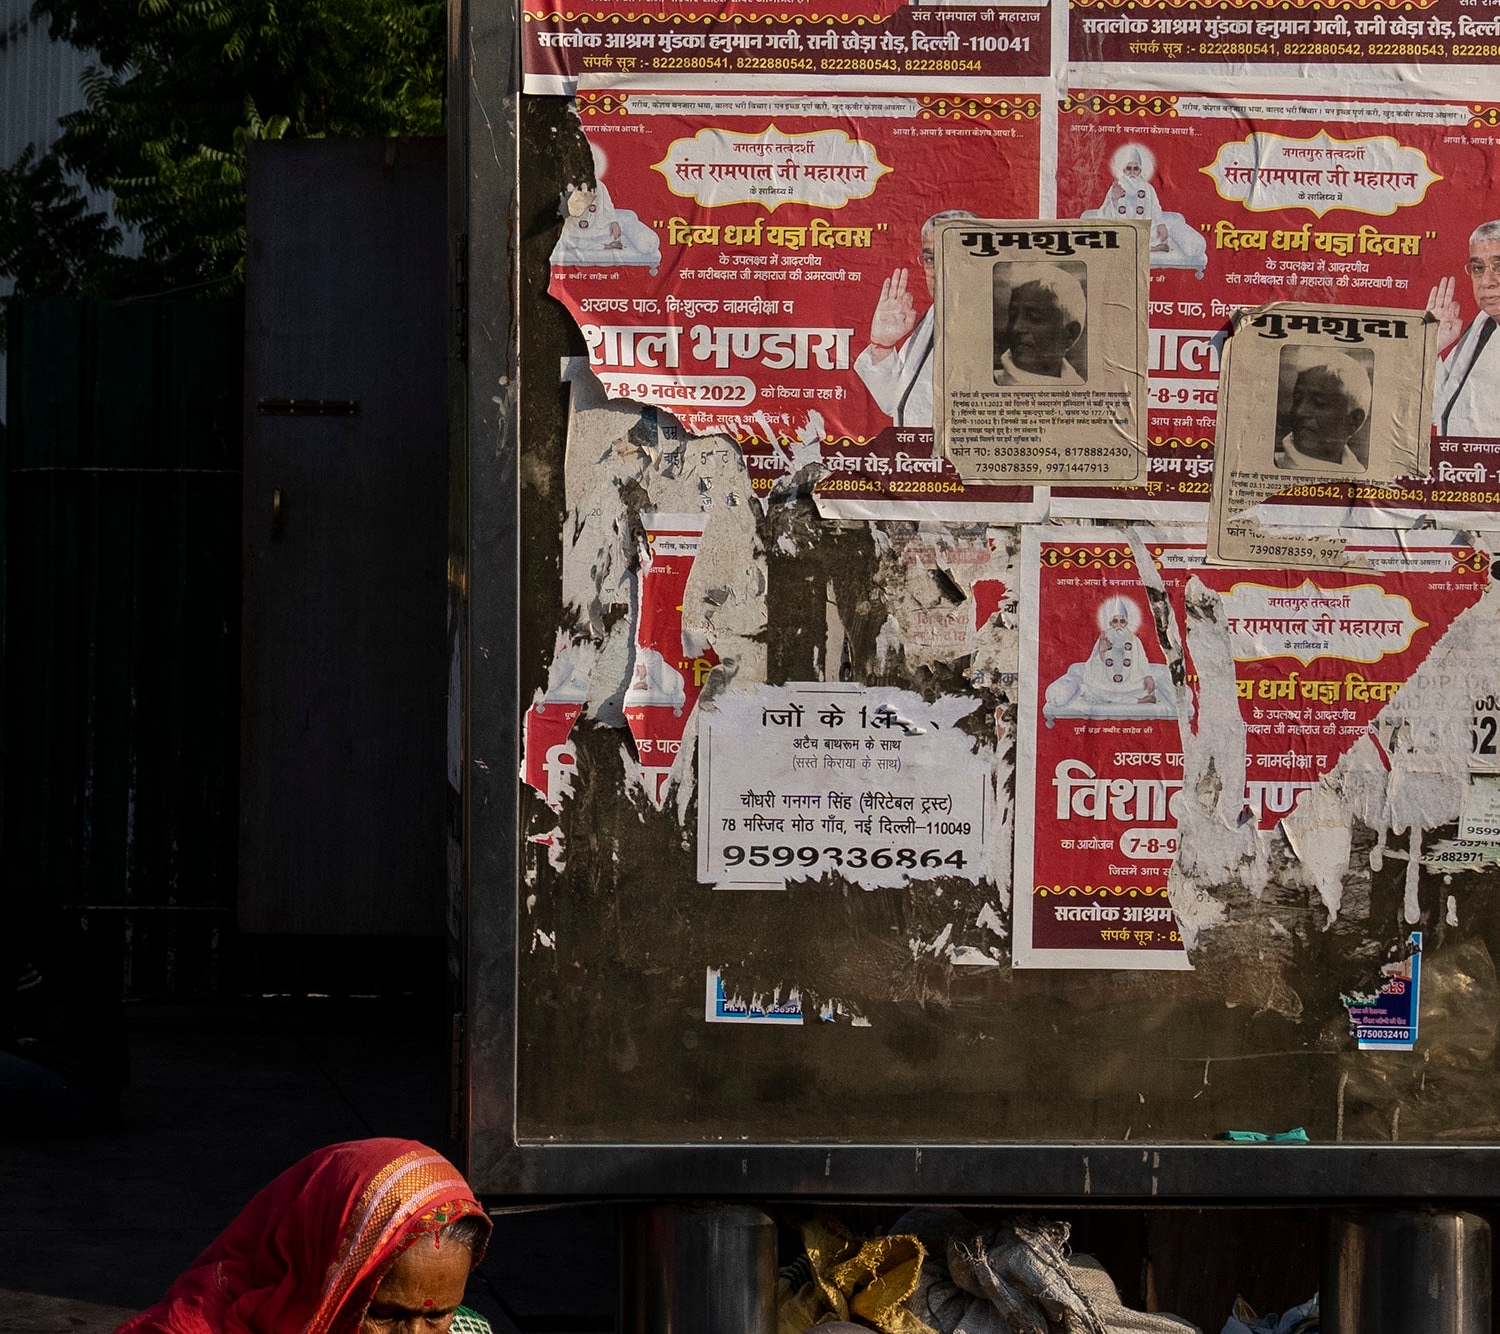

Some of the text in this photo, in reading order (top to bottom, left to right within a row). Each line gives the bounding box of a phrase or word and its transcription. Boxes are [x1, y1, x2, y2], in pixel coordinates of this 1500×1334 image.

[537, 28, 602, 48] सतलोक
[604, 33, 655, 49] आश्रम
[658, 30, 707, 53] मुंडका
[807, 29, 840, 51] रानी
[911, 30, 959, 52] दिल्ली
[583, 54, 613, 69] संपर्क
[616, 57, 637, 72] सूत्र
[652, 57, 732, 70] 8222880541,
[820, 58, 901, 72] 8222880543,
[904, 59, 982, 72] 8222880544
[959, 230, 1121, 257] गुमशुदा
[1252, 313, 1409, 344] गुमशुदा
[652, 381, 746, 401] नवंबर 2022
[952, 445, 1132, 458] फोन 8303830954, 8178882430,
[976, 463, 1109, 474] 7390878359, 9971447913
[1439, 461, 1487, 483] दिल्ली
[1347, 489, 1427, 502] 8222880543,
[793, 735, 901, 751] अटैच बाथरूम के साथ
[823, 755, 856, 770] किराया
[862, 757, 872, 770] के
[740, 790, 776, 810] चौधरी
[782, 794, 821, 809] गनगन
[828, 791, 852, 811] सिंह
[722, 819, 736, 831] 78
[743, 814, 785, 834] मस्जिद
[791, 814, 815, 832] मोठ
[854, 819, 872, 835] नई
[722, 845, 968, 870] 9599336864
[1357, 1029, 1409, 1039] 8750032410
